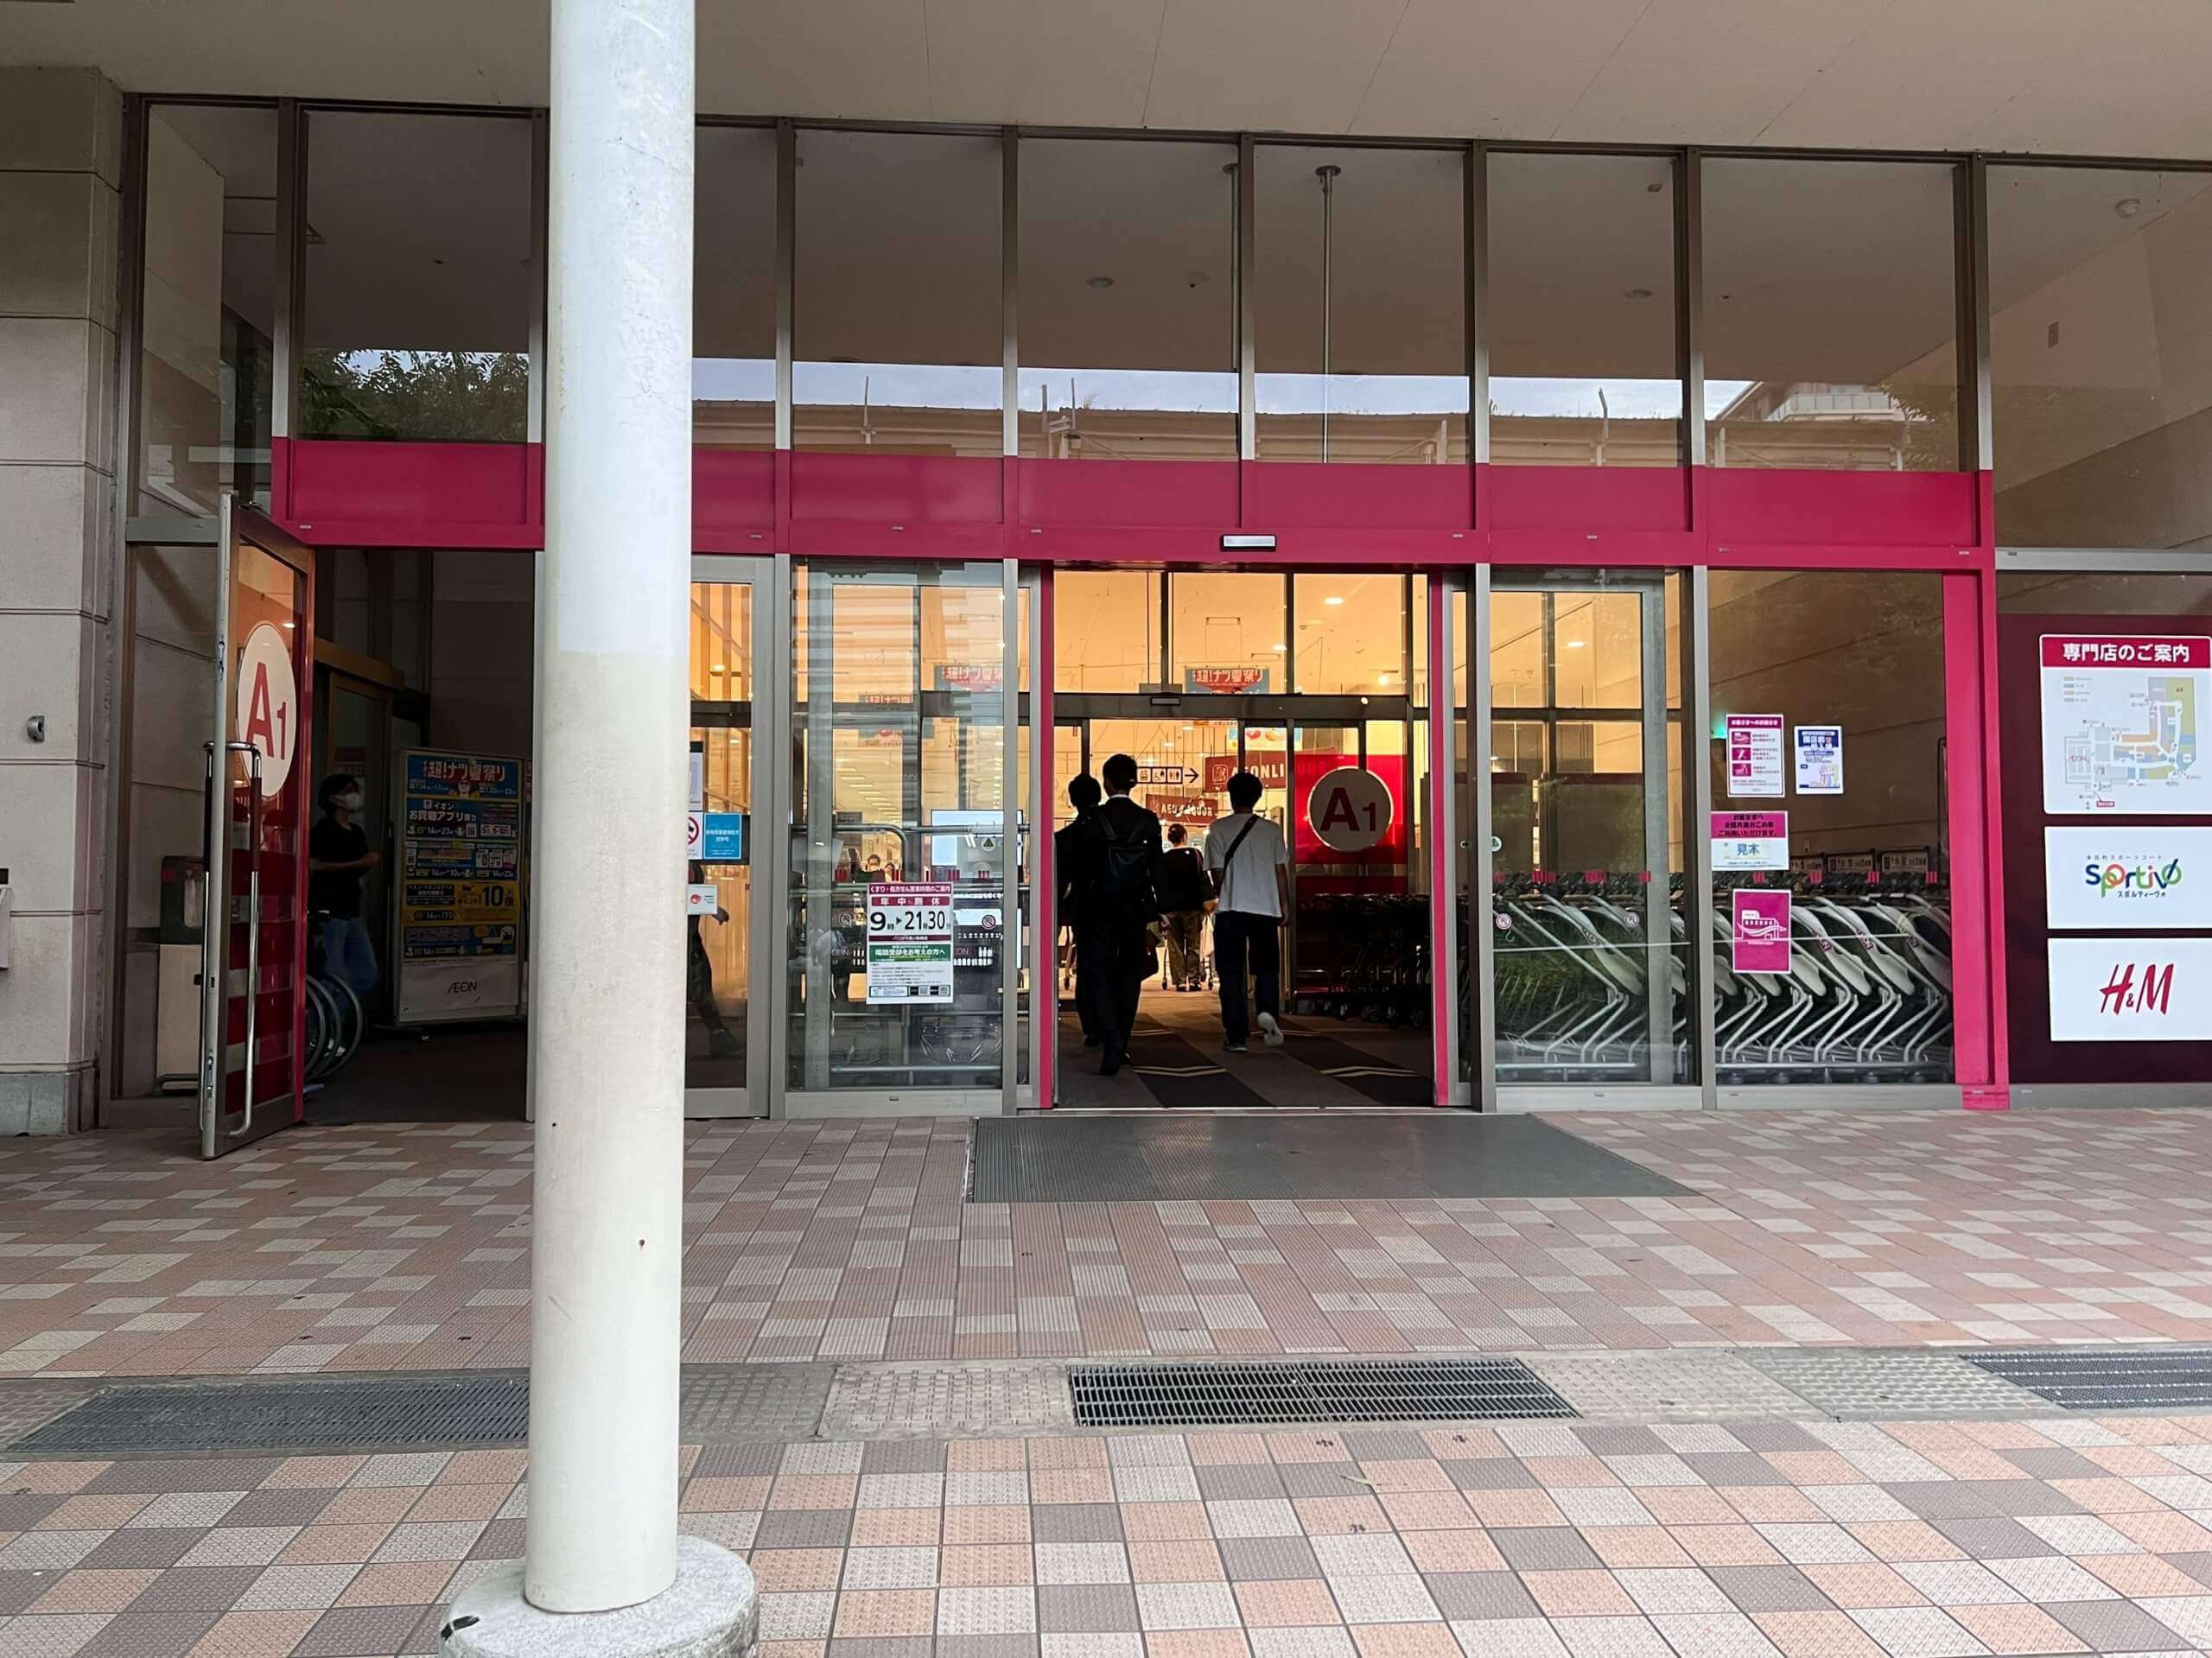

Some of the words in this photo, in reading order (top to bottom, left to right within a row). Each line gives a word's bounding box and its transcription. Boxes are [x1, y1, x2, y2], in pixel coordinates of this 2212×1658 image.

[2063, 643, 2190, 663] 専門店のご案内
[1319, 787, 1376, 832] A1
[1737, 843, 1760, 856] 見本
[2100, 963, 2174, 1015] H&M
